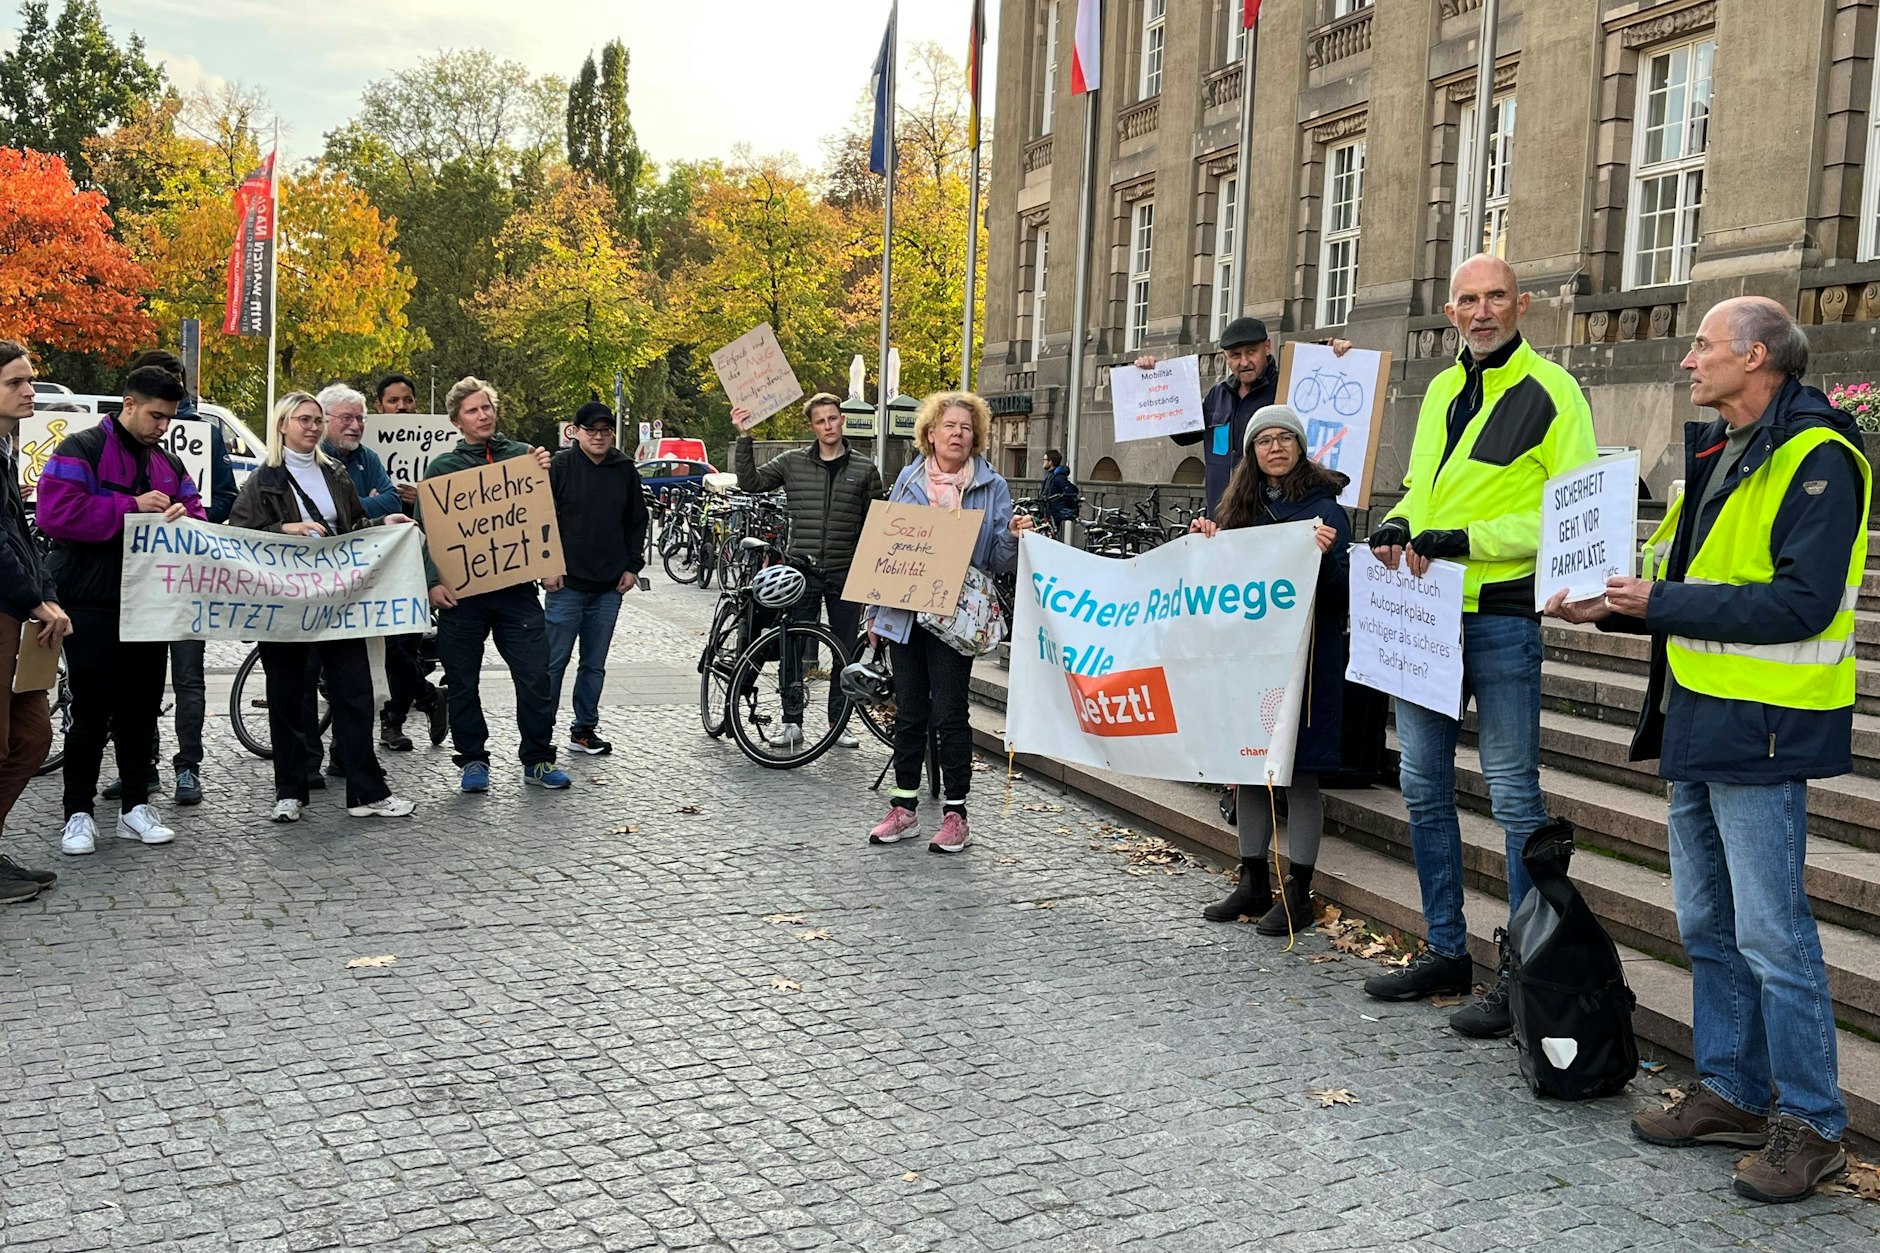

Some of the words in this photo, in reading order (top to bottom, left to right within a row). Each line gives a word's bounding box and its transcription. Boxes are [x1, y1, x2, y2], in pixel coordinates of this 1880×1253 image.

[1141, 369, 1173, 380] Mobilität
[1148, 384, 1169, 393] sicher
[987, 395, 1024, 414] SKELLER
[1139, 395, 1180, 408] selbständig
[378, 425, 458, 451] weniger
[428, 464, 545, 516] Verkehrs-
[1555, 471, 1605, 511] SICHERHEIT
[458, 503, 527, 538] wende
[883, 517, 934, 538] Sozial
[1559, 515, 1579, 543] GEHT
[1582, 507, 1600, 534] VOR
[887, 542, 935, 556] gerechte
[1551, 541, 1606, 578] PARKPLÄTZE
[874, 557, 927, 577] Mobilität
[1396, 571, 1416, 591] Sind
[1418, 577, 1441, 598] Euch
[191, 601, 284, 633] JETZT
[301, 597, 428, 632] UMSETZEN
[1032, 572, 1140, 628] Sichere
[1143, 577, 1297, 625] Radwege
[1370, 591, 1436, 626] Autoparkplätze
[1038, 625, 1058, 666] für
[1062, 645, 1114, 677] alle
[1359, 617, 1398, 643] wichtiger
[1399, 628, 1412, 646] als
[1413, 634, 1450, 658] sicheres
[1378, 648, 1429, 679] Radfahren?
[1075, 684, 1156, 725] Jetzt!
